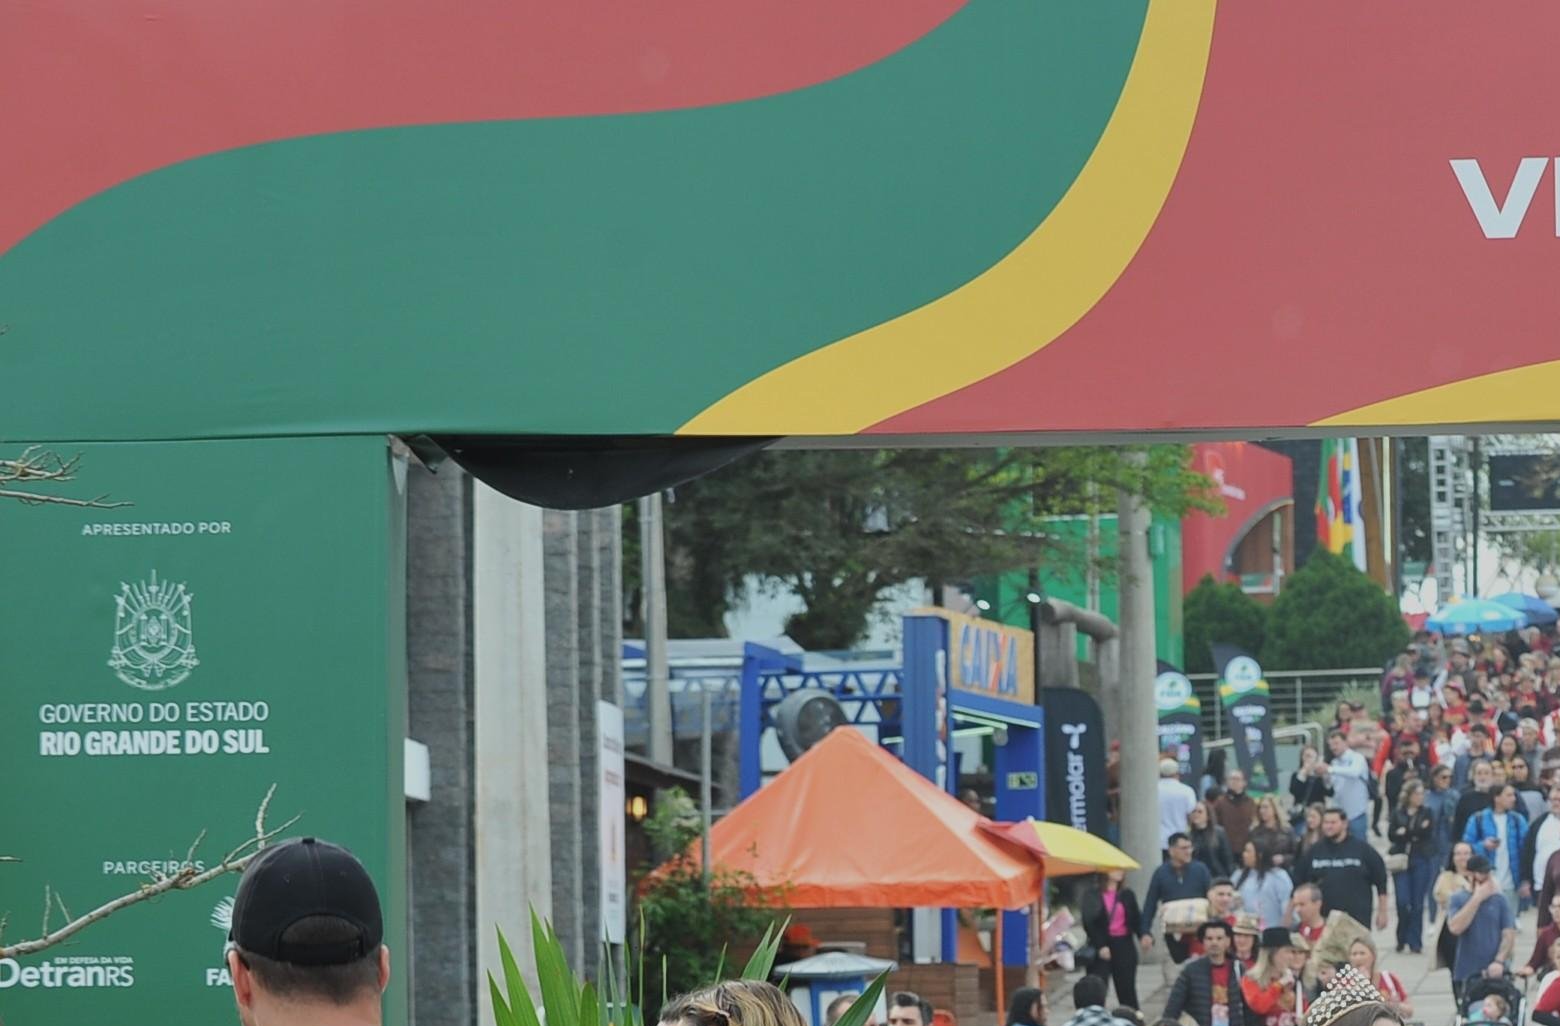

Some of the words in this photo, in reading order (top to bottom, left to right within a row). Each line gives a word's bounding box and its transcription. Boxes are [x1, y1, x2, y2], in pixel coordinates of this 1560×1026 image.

[82, 523, 195, 535] APRESENTADO
[198, 522, 231, 534] POR
[39, 703, 143, 724] GOVERNO
[149, 703, 180, 723] DO
[186, 701, 269, 722] ESTADO
[40, 731, 81, 756] RIO
[84, 730, 181, 755] GRANDE
[185, 729, 219, 754] DO
[222, 729, 270, 754] SUL
[1068, 752, 1087, 833] ermolar
[54, 956, 68, 964] EM
[69, 956, 99, 964] DEFESA
[0, 957, 134, 988] DetranRS
[206, 968, 232, 986] FA
